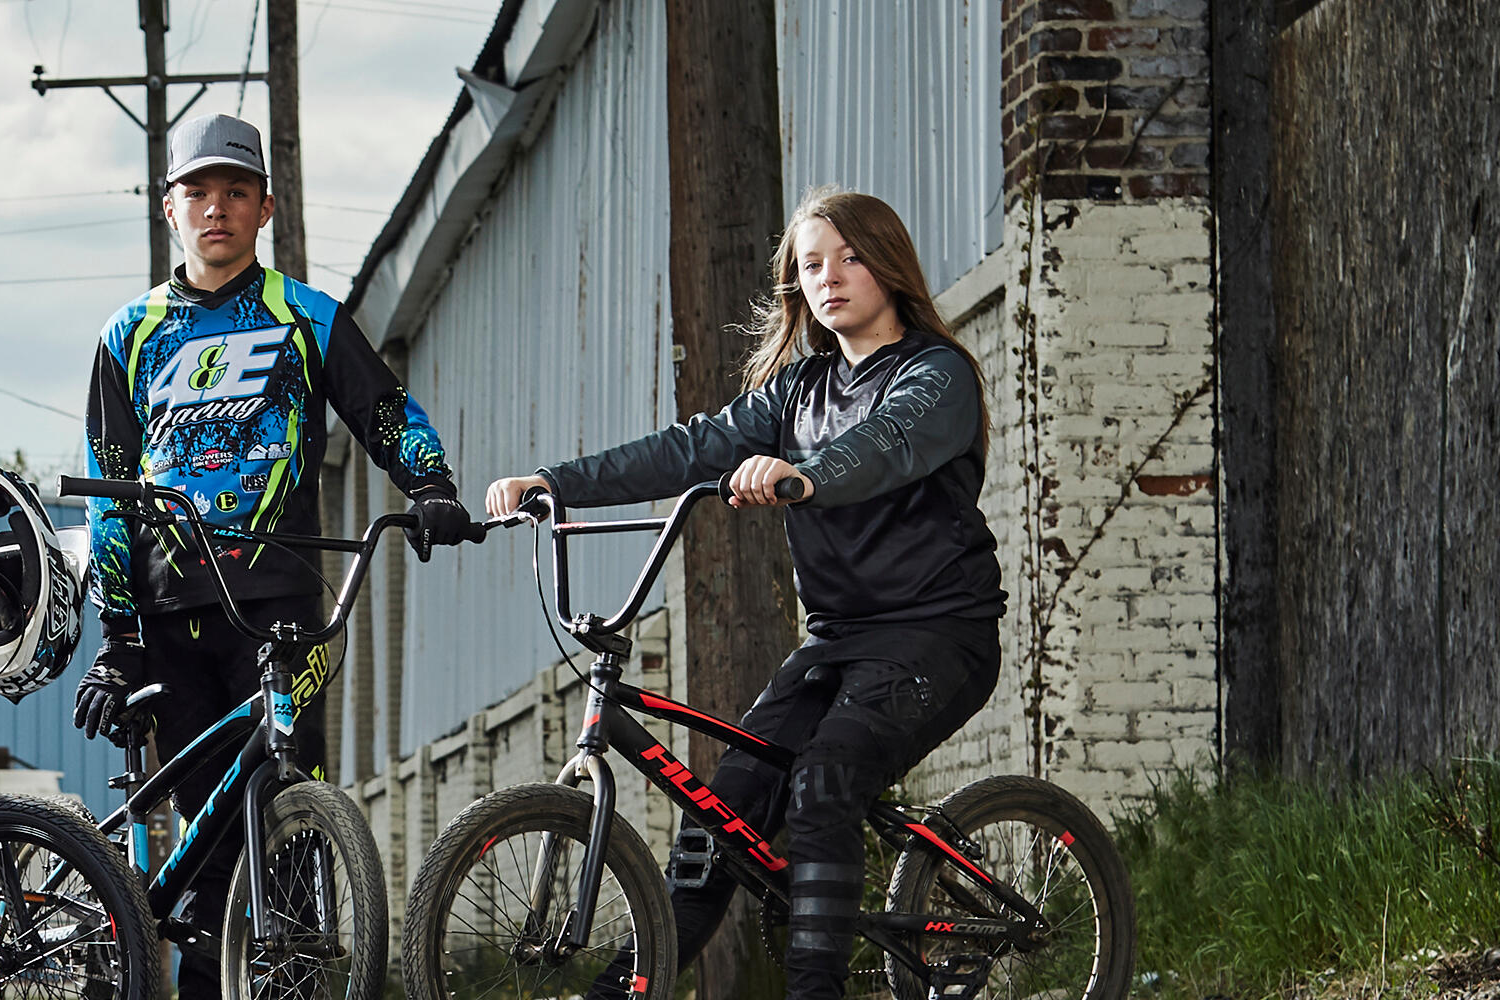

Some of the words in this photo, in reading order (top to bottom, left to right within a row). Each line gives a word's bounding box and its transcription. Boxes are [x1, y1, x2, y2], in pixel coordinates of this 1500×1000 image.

[147, 396, 268, 447] Racing
[192, 452, 233, 463] POWERS
[211, 457, 233, 466] SHOP
[219, 493, 237, 510] E
[793, 763, 858, 809] FLY
[641, 743, 789, 872] HUFFY
